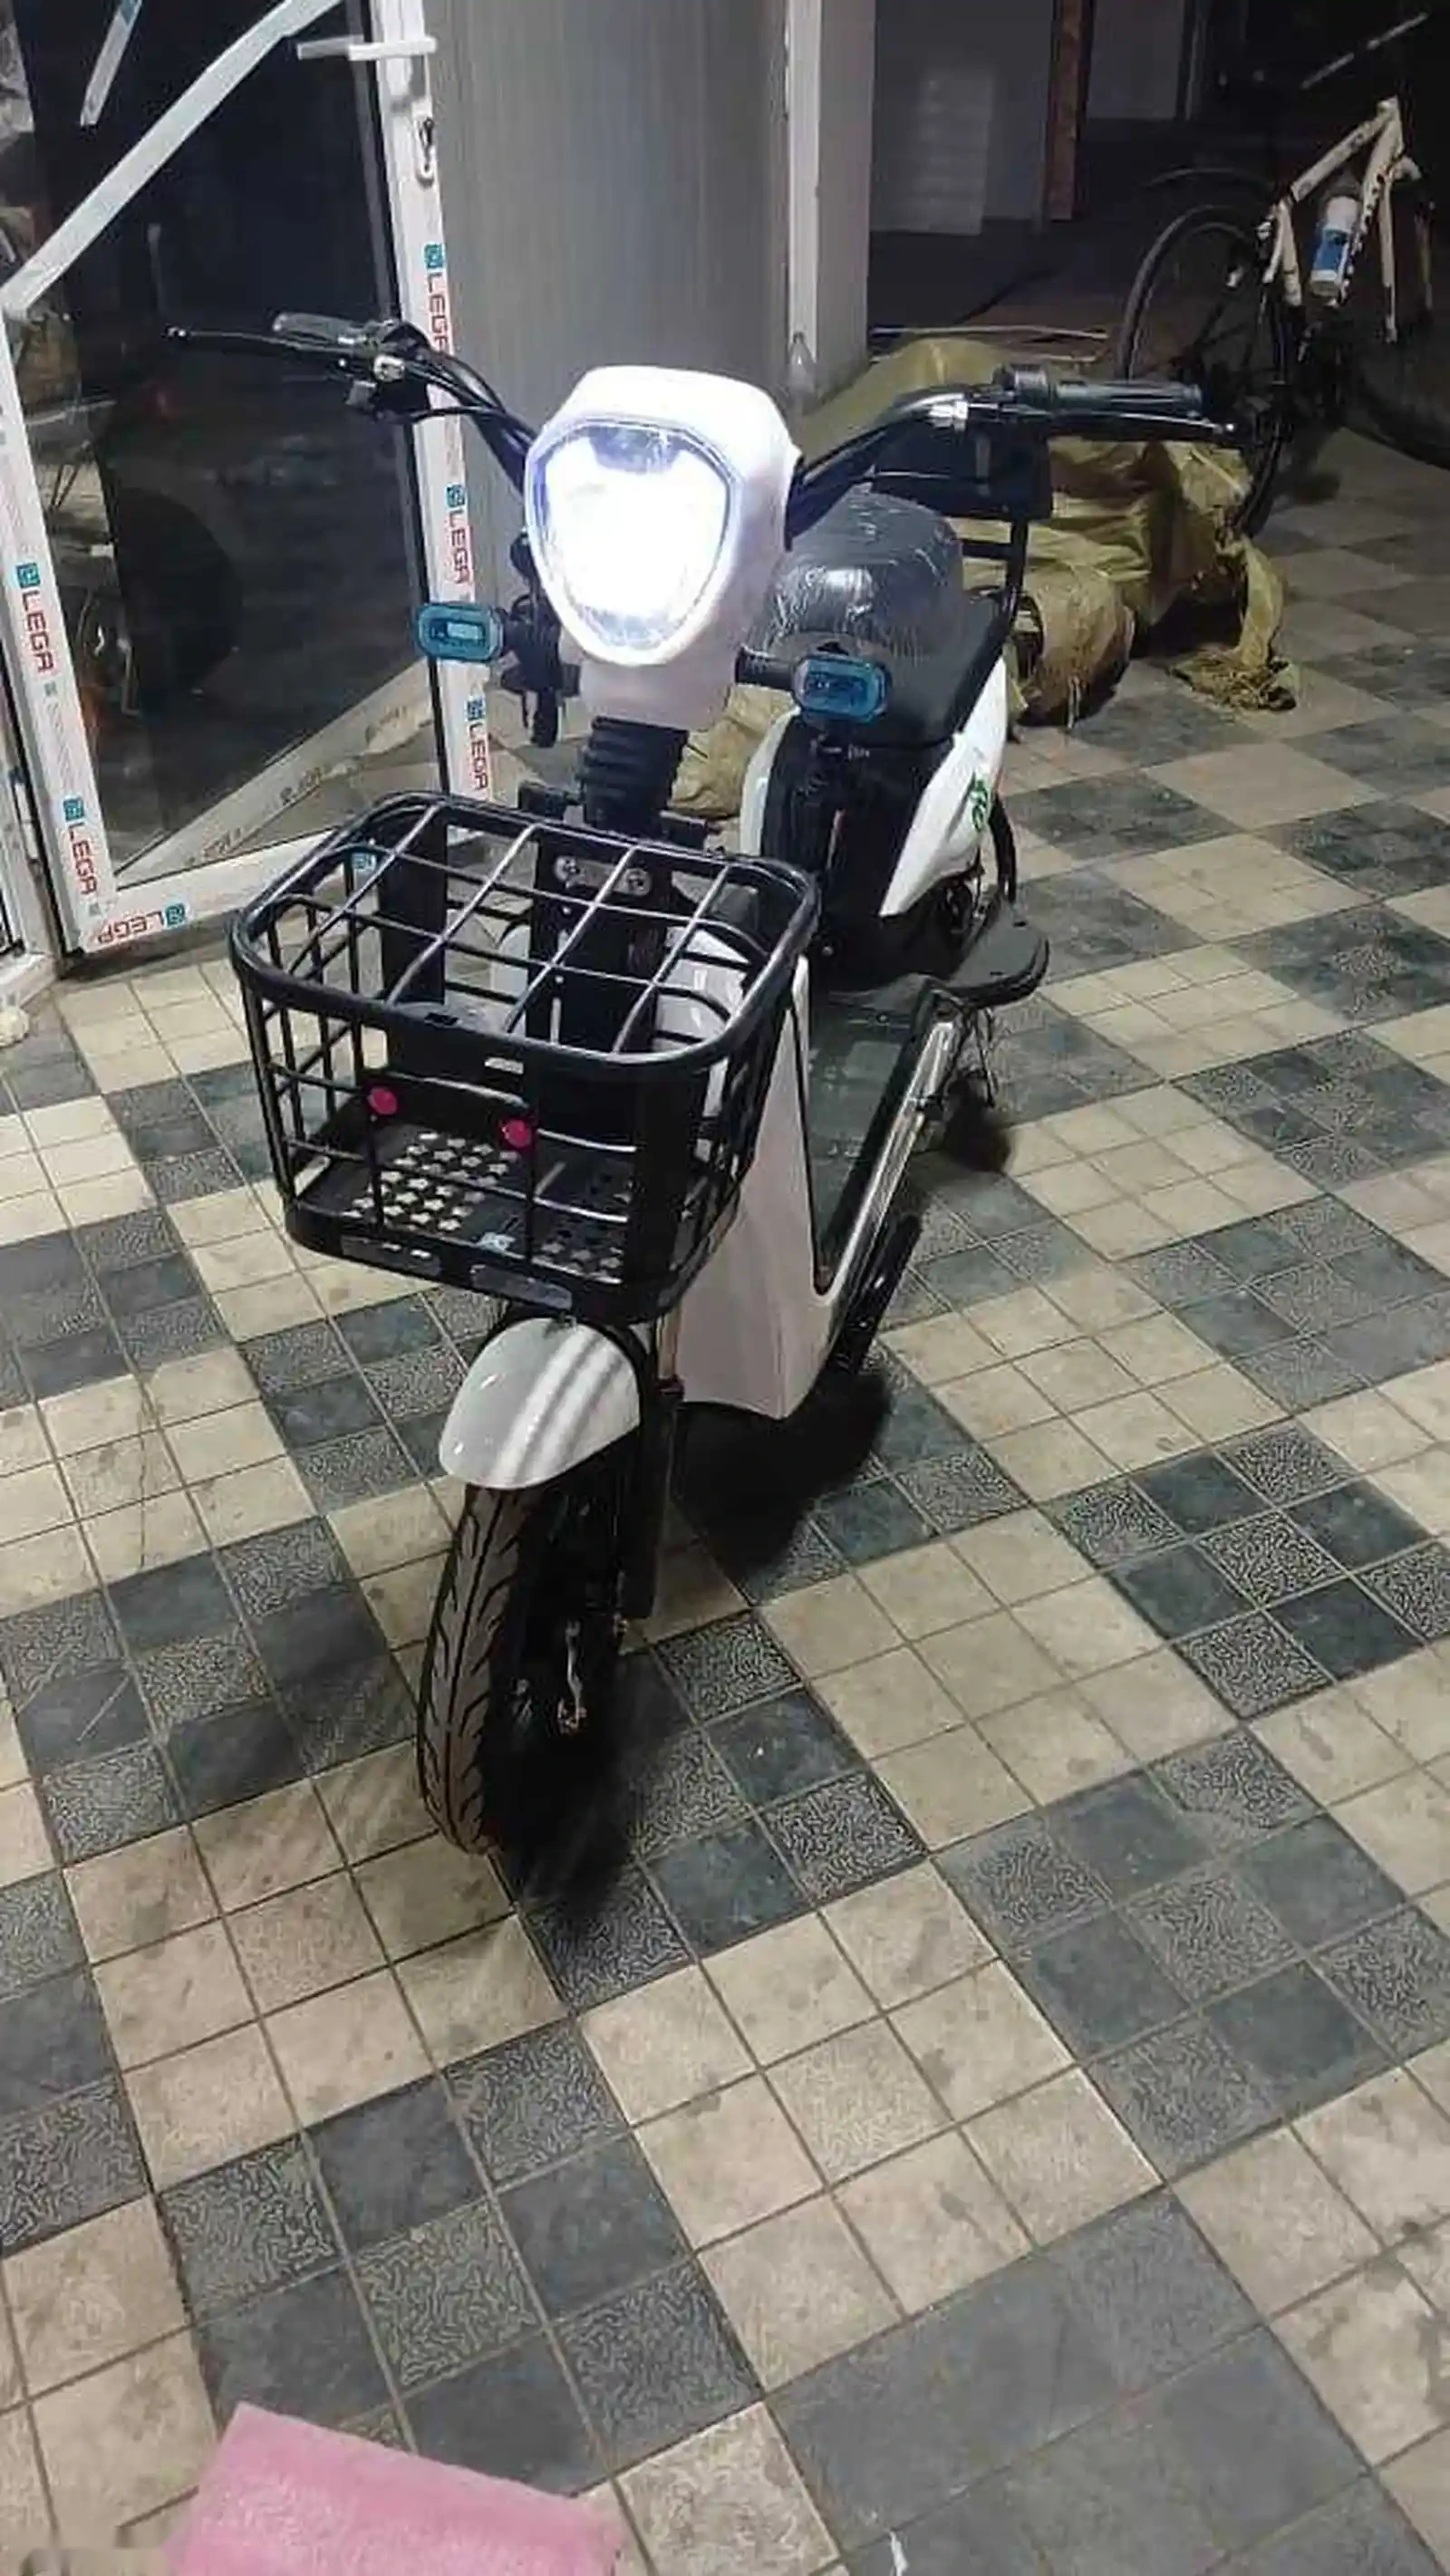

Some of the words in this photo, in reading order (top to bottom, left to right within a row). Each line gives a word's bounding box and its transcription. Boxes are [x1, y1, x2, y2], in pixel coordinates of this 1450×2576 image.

[449, 508, 469, 584] LEGA
[22, 590, 53, 672] LEGA
[469, 722, 488, 789] LEGA
[68, 821, 97, 895] LEGA
